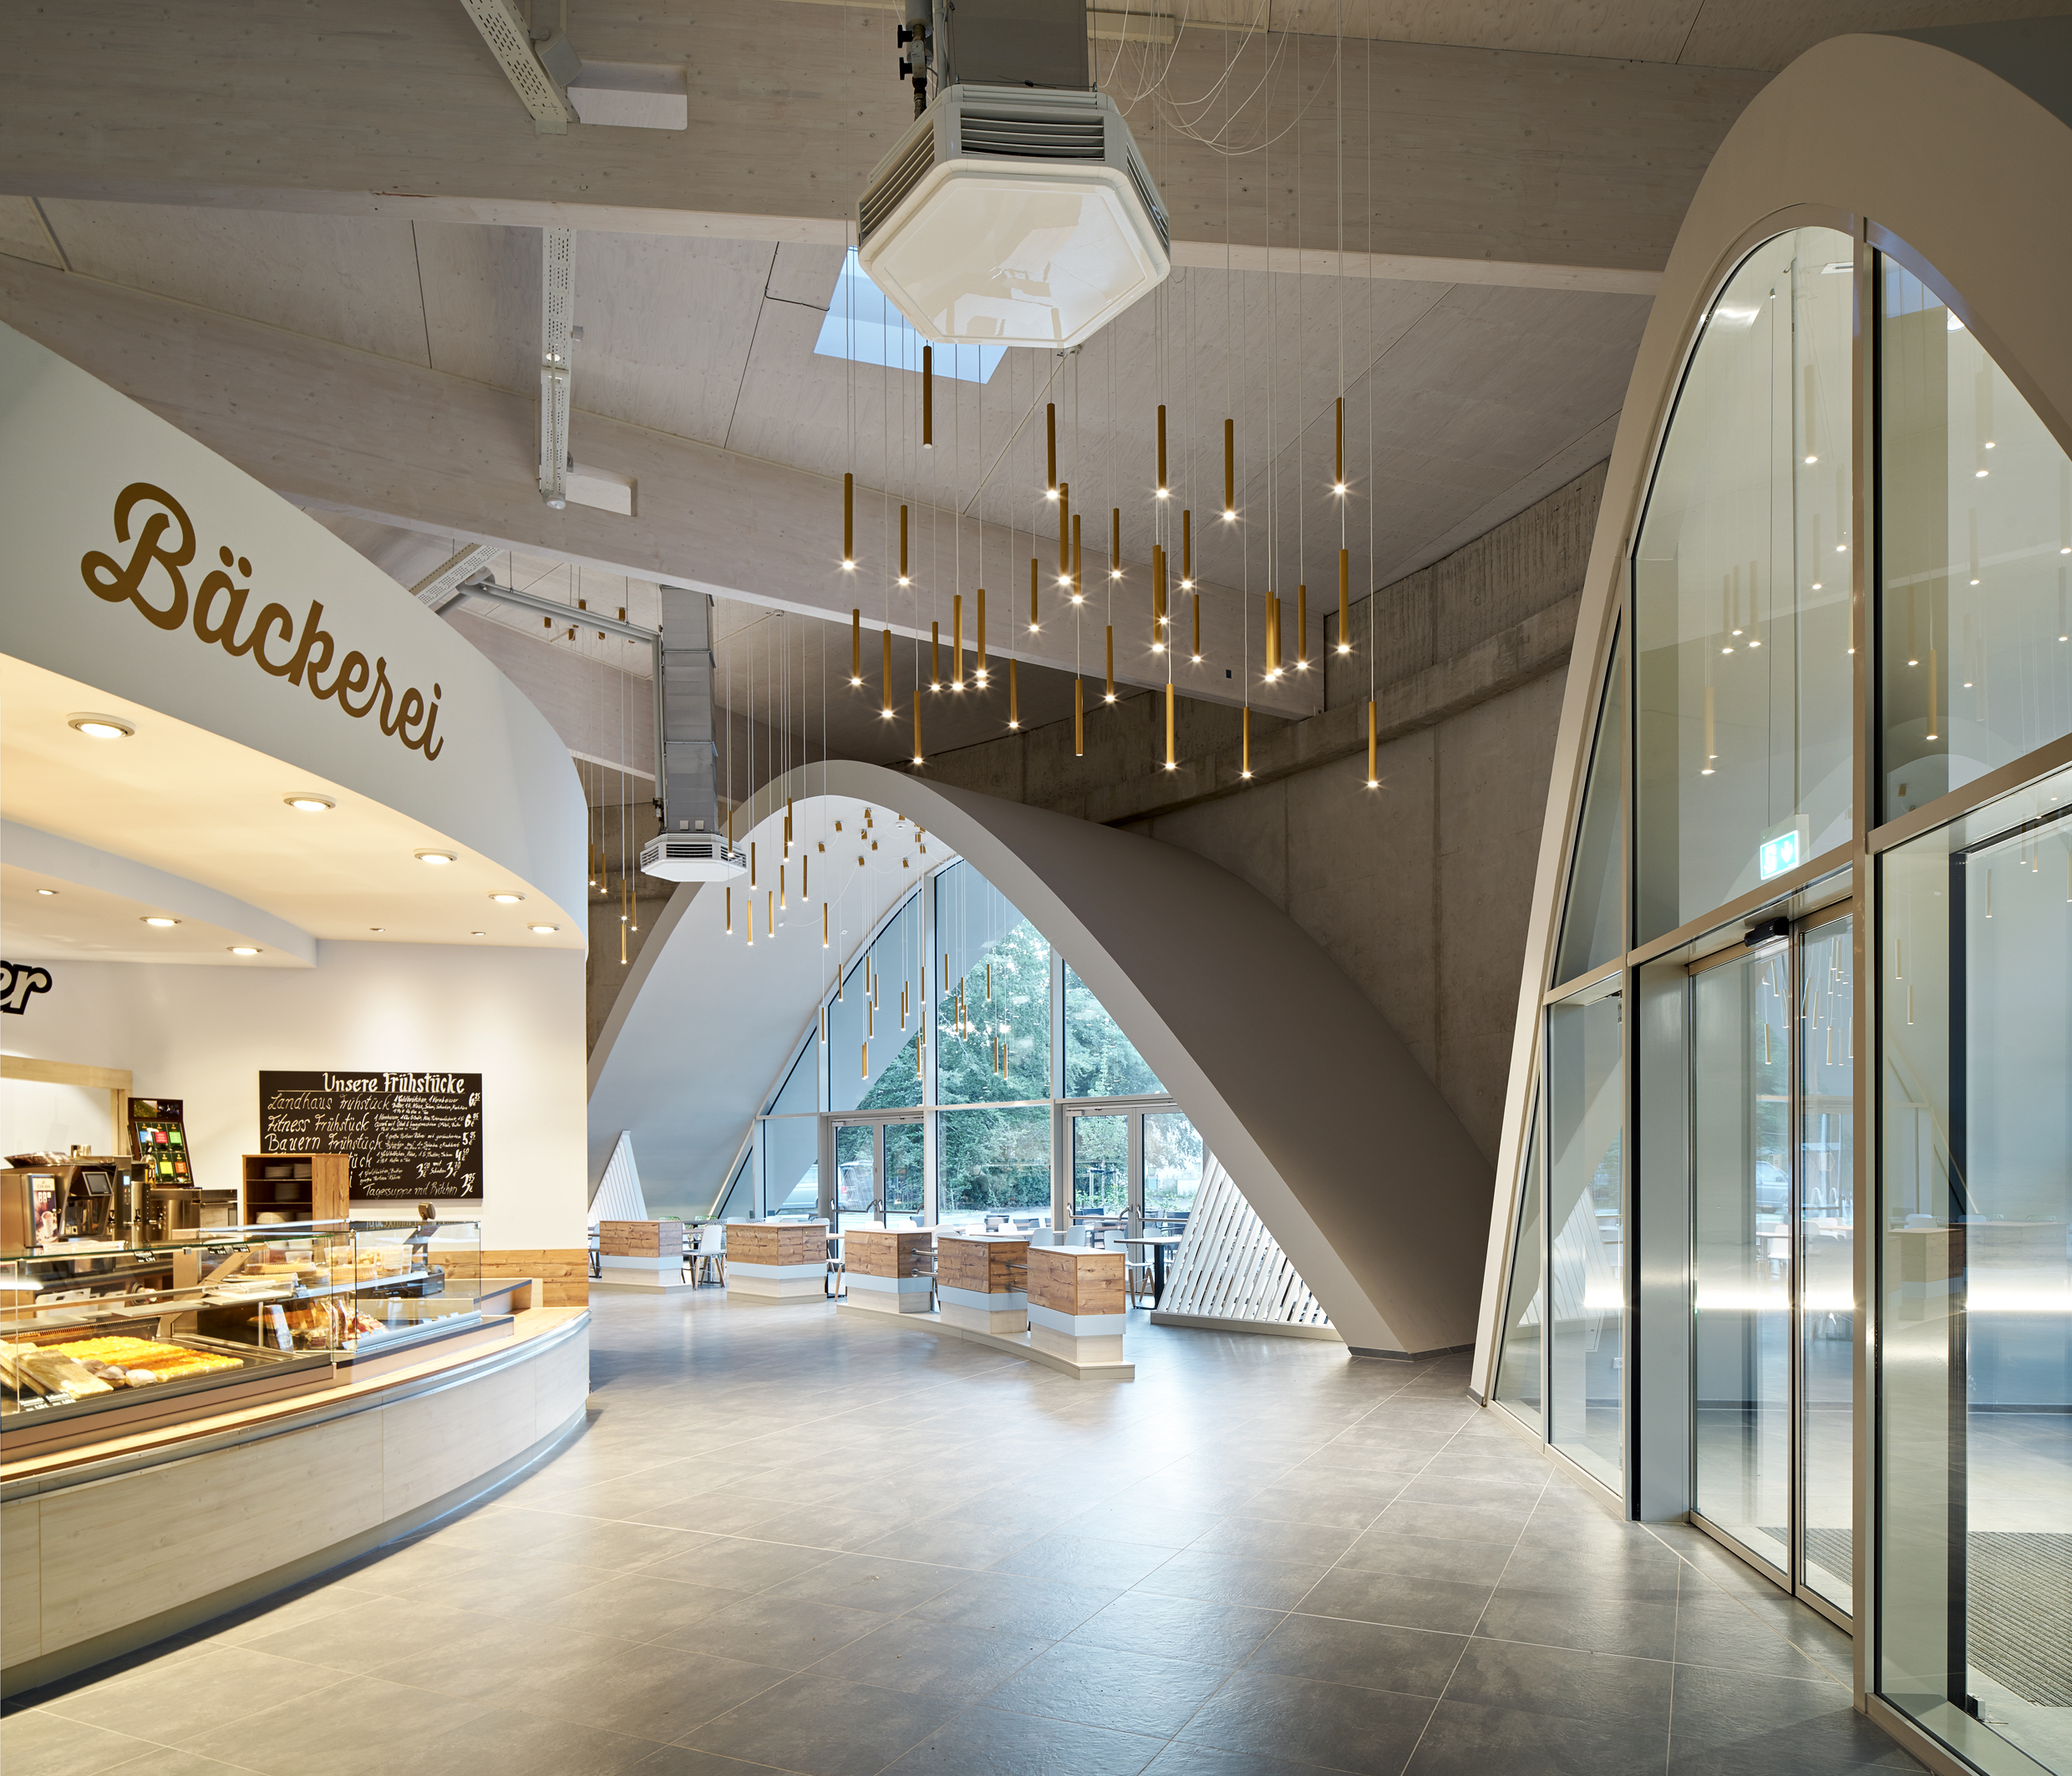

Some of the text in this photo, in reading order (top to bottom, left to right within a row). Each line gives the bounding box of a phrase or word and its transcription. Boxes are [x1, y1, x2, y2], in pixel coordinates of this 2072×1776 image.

[81, 482, 444, 761] Bäckerei
[322, 1072, 465, 1094] Unsere Frühstücke
[267, 1092, 392, 1110] Landhaus Frühstück
[267, 1112, 370, 1133] Fitness Frühstück
[265, 1132, 384, 1151] Bauern Frühstück
[363, 1181, 459, 1200] Tagessuppe mit Brötchen
